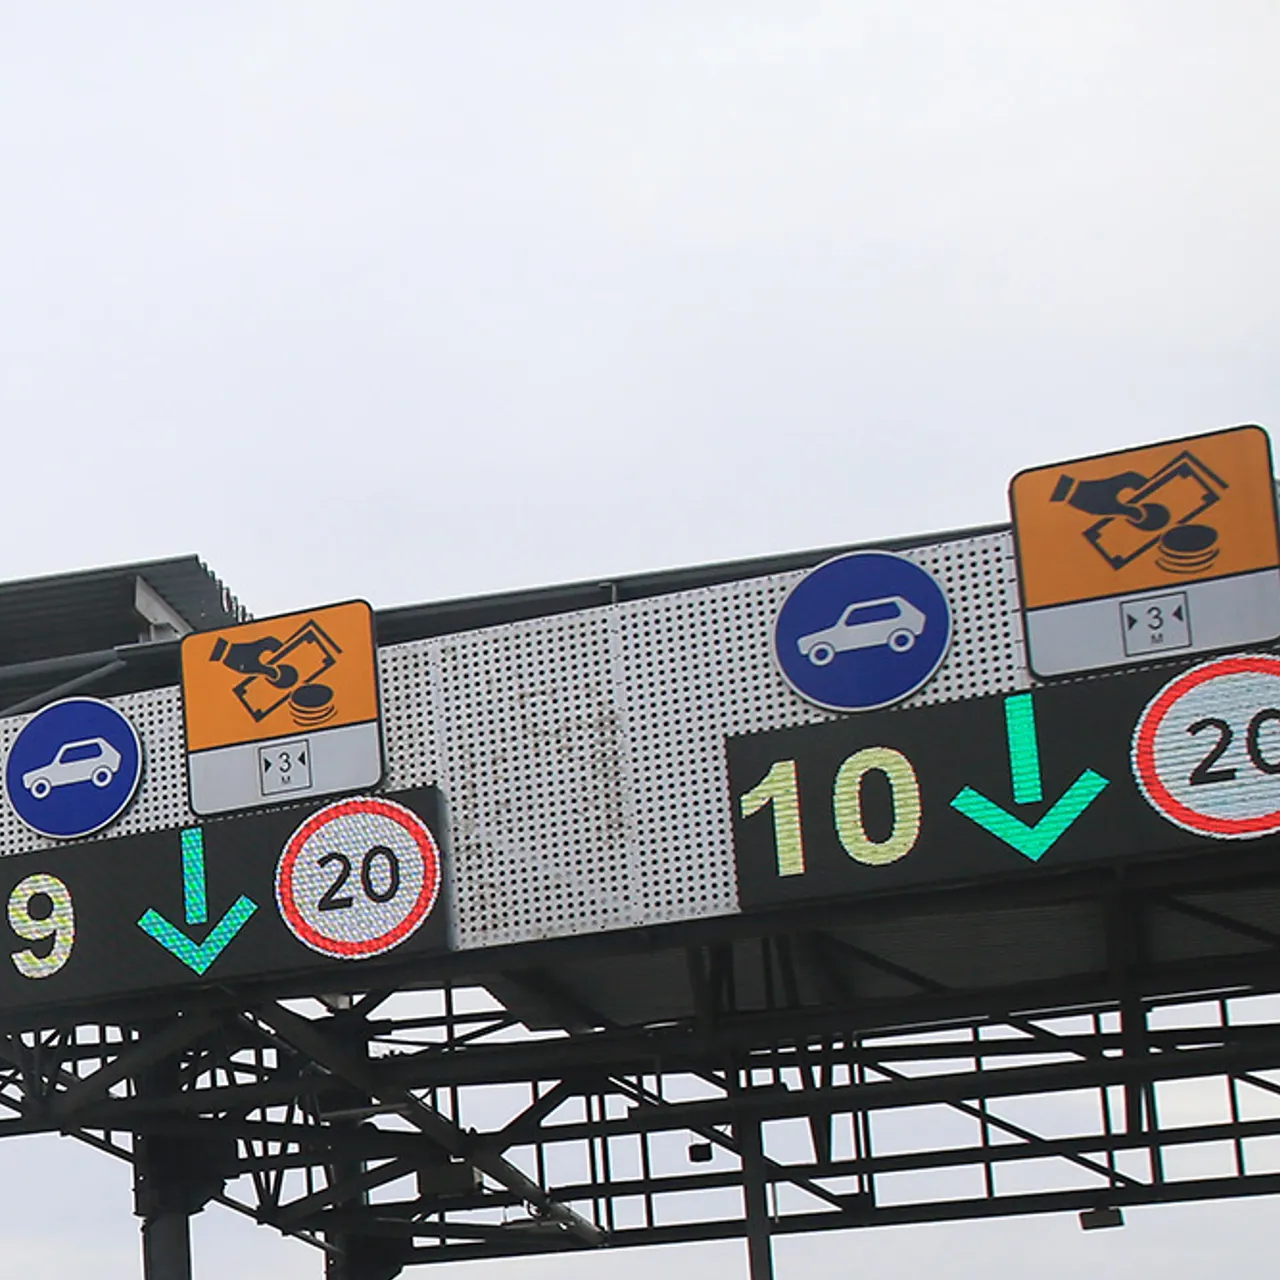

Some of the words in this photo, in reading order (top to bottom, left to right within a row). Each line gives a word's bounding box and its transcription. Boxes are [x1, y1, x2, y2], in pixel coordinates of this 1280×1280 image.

[1146, 606, 1165, 630] 3
[279, 752, 292, 773] 3
[1187, 708, 1280, 785] 20
[740, 746, 922, 877] 10
[316, 845, 401, 912] 20
[6, 873, 77, 980] 9
